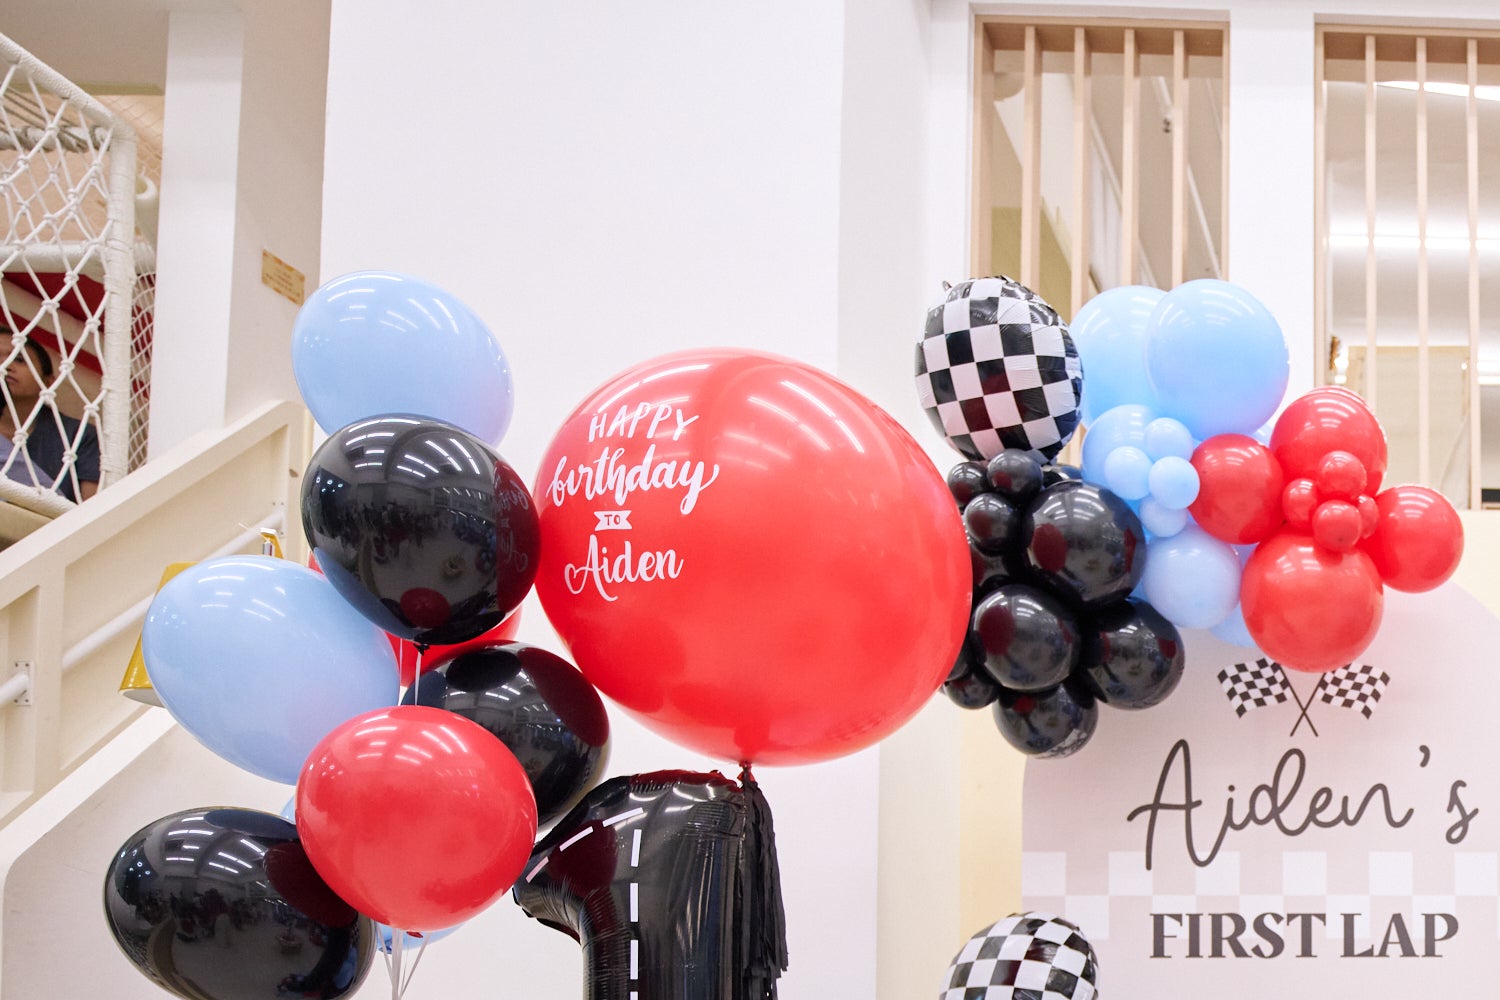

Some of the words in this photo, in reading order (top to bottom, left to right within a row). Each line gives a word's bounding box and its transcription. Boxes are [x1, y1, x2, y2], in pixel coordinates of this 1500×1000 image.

[588, 402, 699, 442] HAPPY
[546, 444, 720, 515] birthday
[604, 514, 621, 526] TO
[564, 534, 684, 602] Aiden
[1126, 738, 1479, 871] Aiden's
[1149, 913, 1326, 959] FIRST
[1340, 912, 1460, 959] LAP
